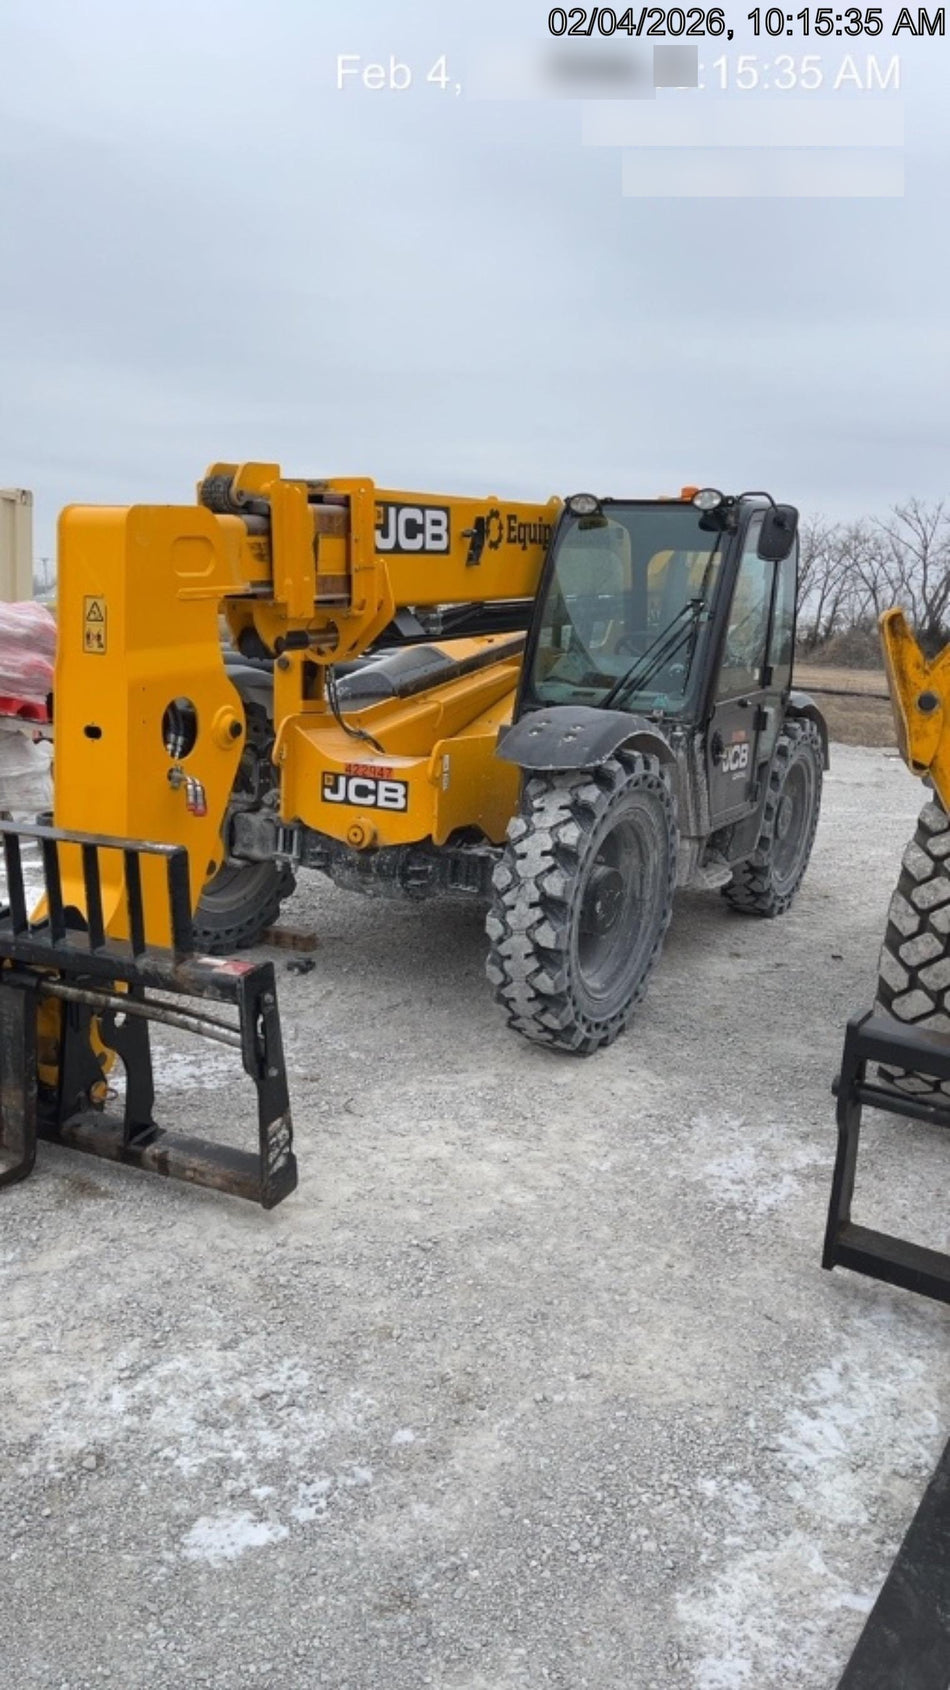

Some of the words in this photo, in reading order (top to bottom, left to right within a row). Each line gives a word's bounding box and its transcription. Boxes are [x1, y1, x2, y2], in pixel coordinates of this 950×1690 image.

[375, 506, 448, 550] JCB
[344, 763, 393, 779] 422947
[722, 743, 750, 773] JCB
[323, 775, 406, 809] JCB
